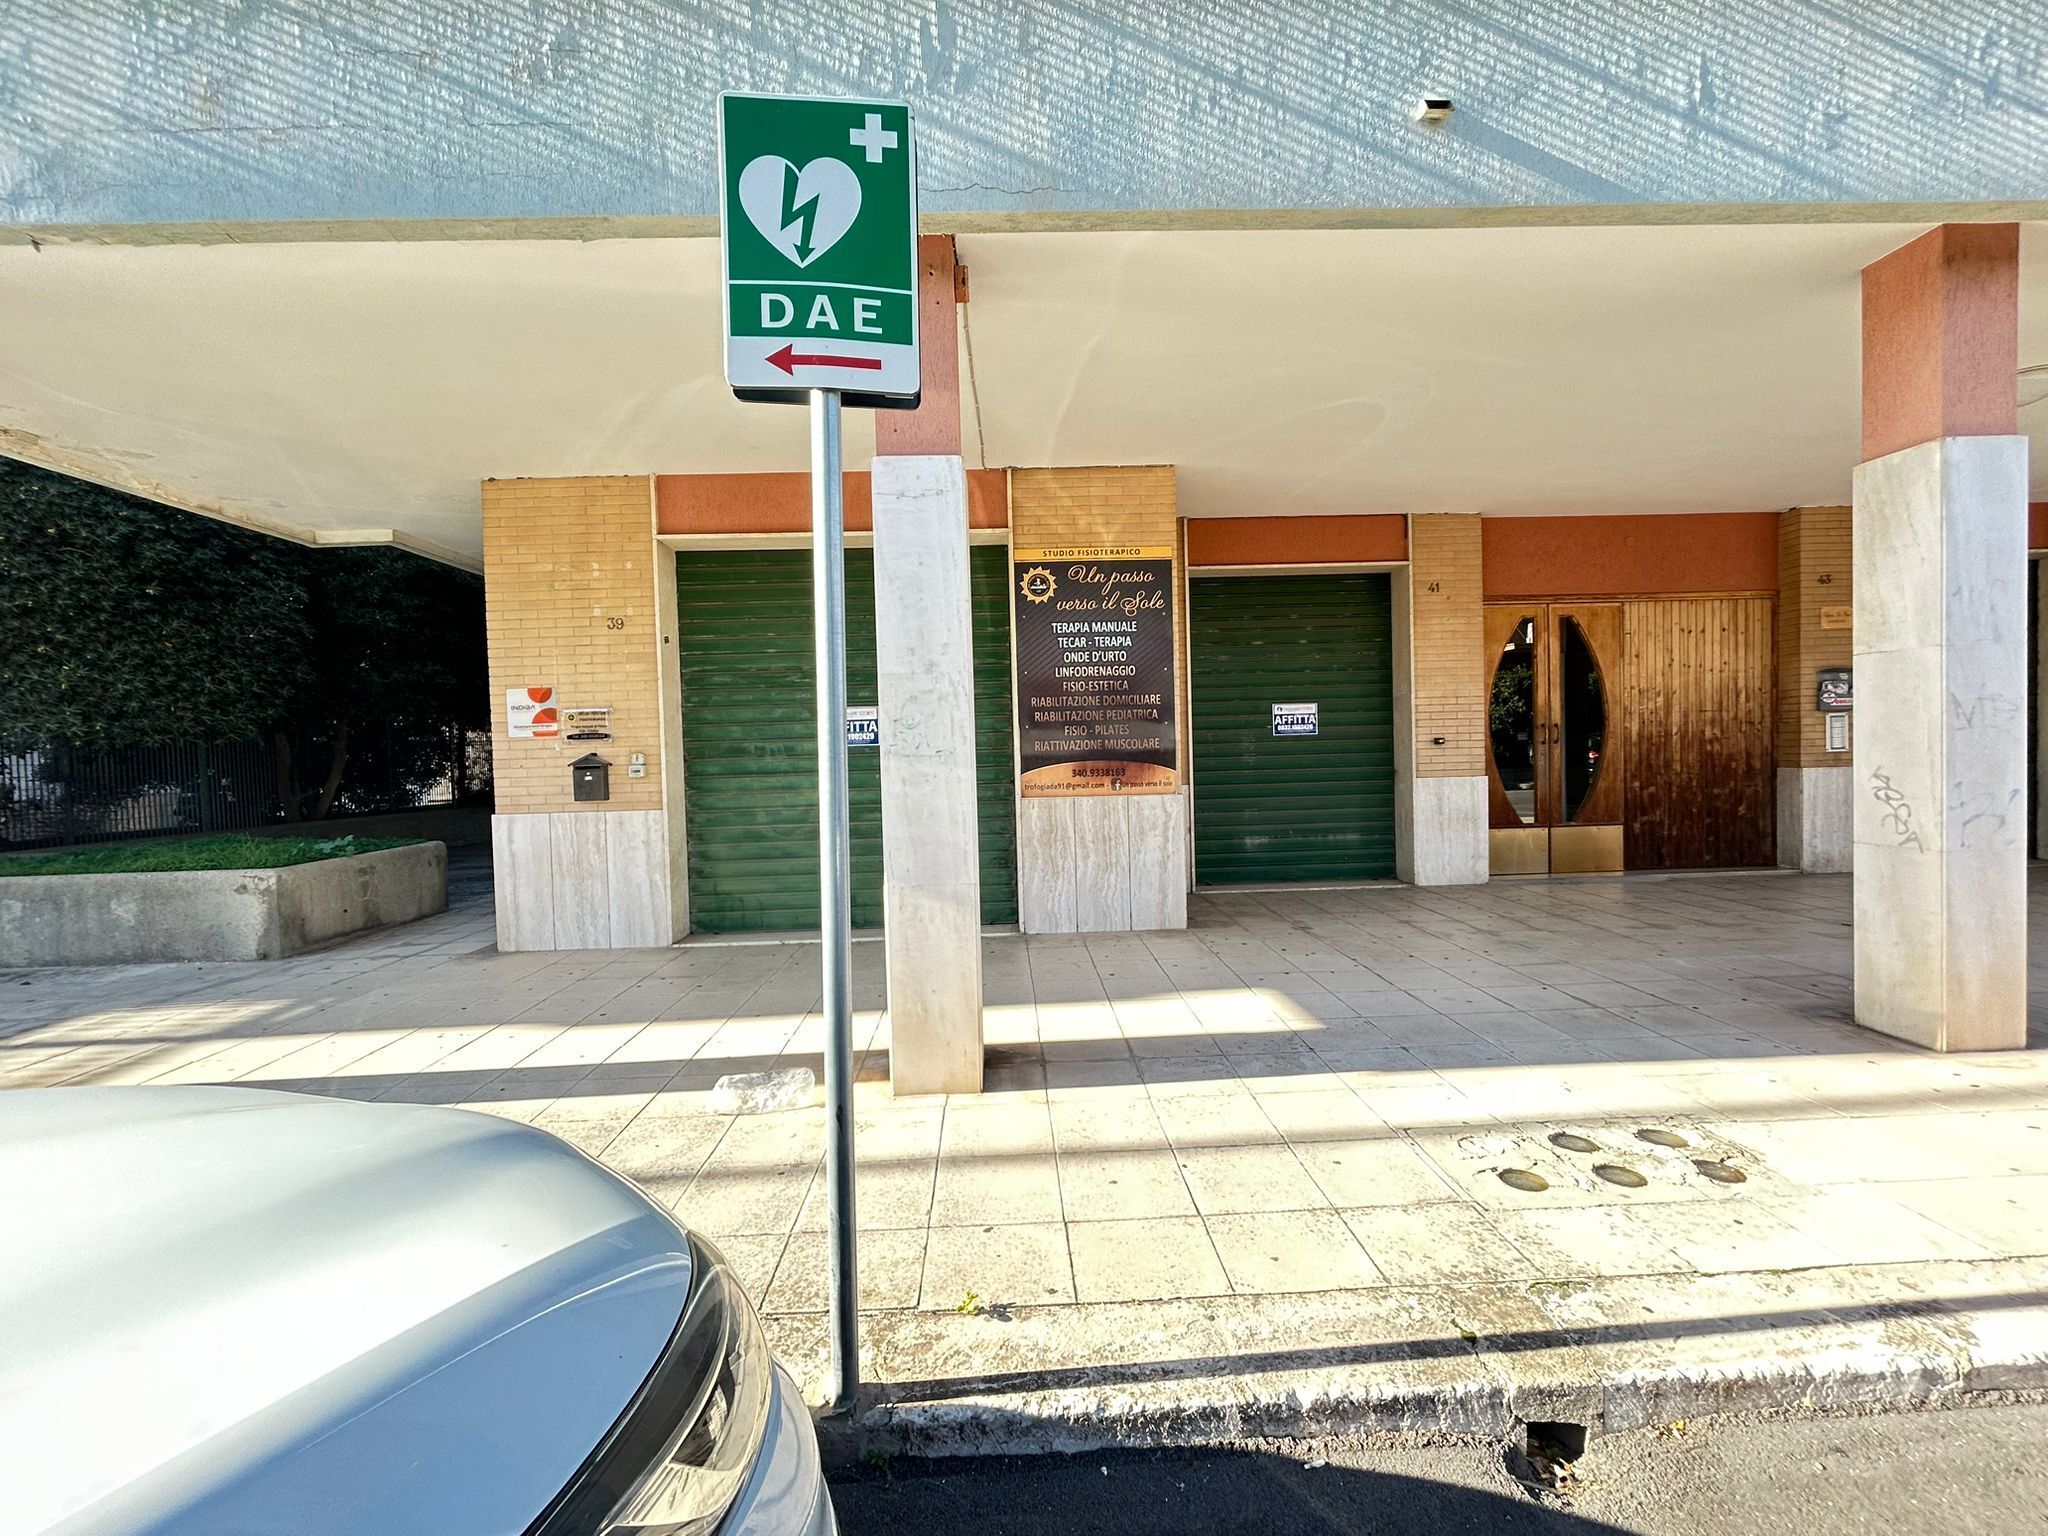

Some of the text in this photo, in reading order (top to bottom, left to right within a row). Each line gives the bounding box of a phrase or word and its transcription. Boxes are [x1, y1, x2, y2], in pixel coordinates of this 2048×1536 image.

[760, 293, 882, 334] DAE
[1043, 548, 1141, 557] STUDIO FISIOTERAPICO
[1068, 564, 1155, 595] Un passo
[1428, 582, 1440, 592] 41
[1056, 590, 1165, 616] verso il Sole
[607, 617, 624, 630] 39
[1052, 621, 1137, 633] TERAPIA MANUALE
[1057, 637, 1087, 648] TECAR
[1094, 636, 1132, 647] TERAPIA
[1064, 651, 1127, 662] ONDE D'URTO
[1055, 666, 1136, 677] LINFODRENAGGIO
[1063, 680, 1129, 692] FISIO-ESTETICA
[1031, 694, 1161, 707] RIABILITAZIONE DOMICILIARE
[1034, 709, 1158, 722] RIABILITAZIONE PEDIATRICA
[1275, 715, 1316, 724] AFFITTA
[1064, 725, 1087, 736] FISIO
[1095, 724, 1130, 735] PILATES
[1034, 738, 1160, 751] RIATTIVAZIONE MUSCOLARE
[1072, 768, 1126, 778] 340.9338163
